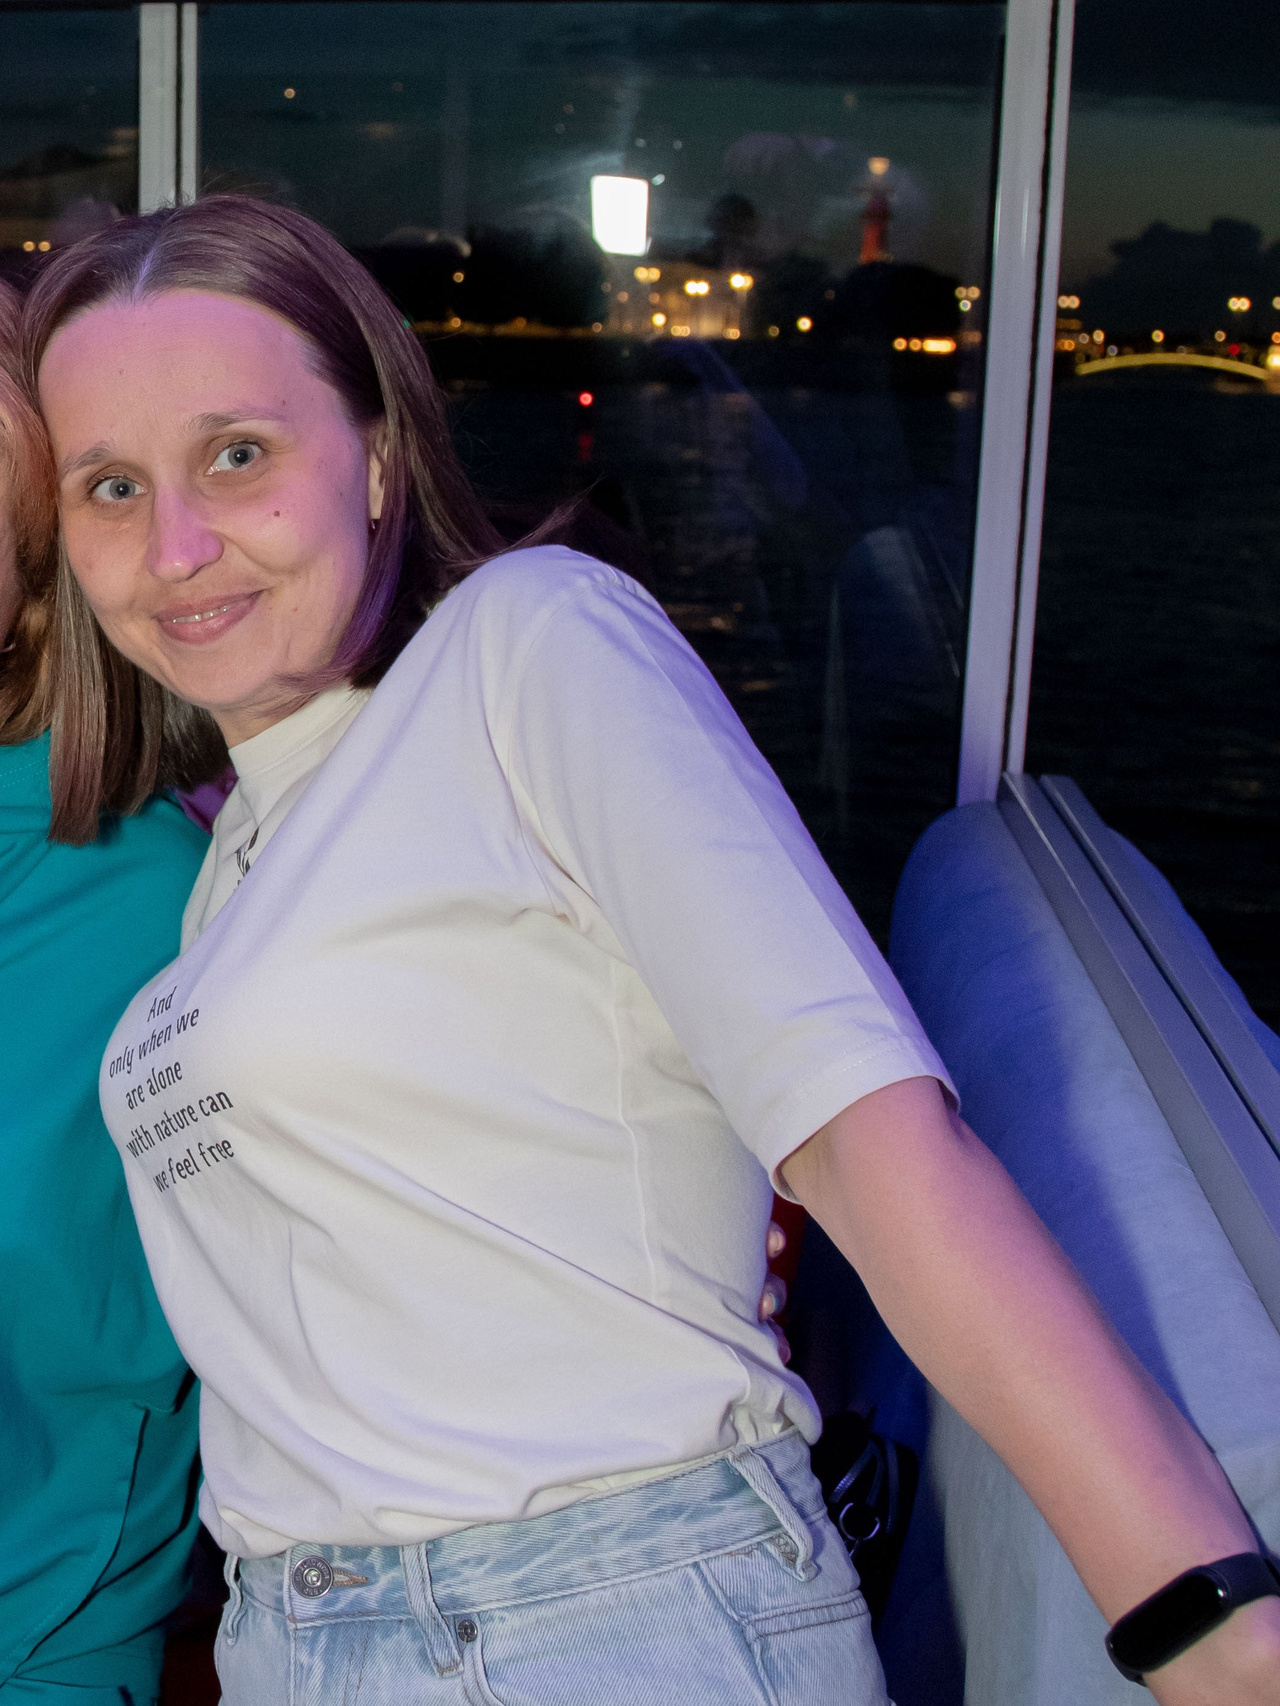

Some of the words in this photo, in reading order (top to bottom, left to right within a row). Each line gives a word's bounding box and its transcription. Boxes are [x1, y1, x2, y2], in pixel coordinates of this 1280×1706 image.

[147, 986, 177, 1022] And
[109, 1046, 134, 1079] only
[138, 1022, 172, 1060] when
[176, 1008, 200, 1034] we
[125, 1084, 145, 1110] are
[147, 1061, 183, 1097] alone
[126, 1124, 156, 1159] with
[153, 1103, 199, 1142] nature
[199, 1091, 234, 1117] can
[153, 1170, 169, 1193] we
[168, 1149, 201, 1184] feel
[197, 1139, 235, 1167] free
